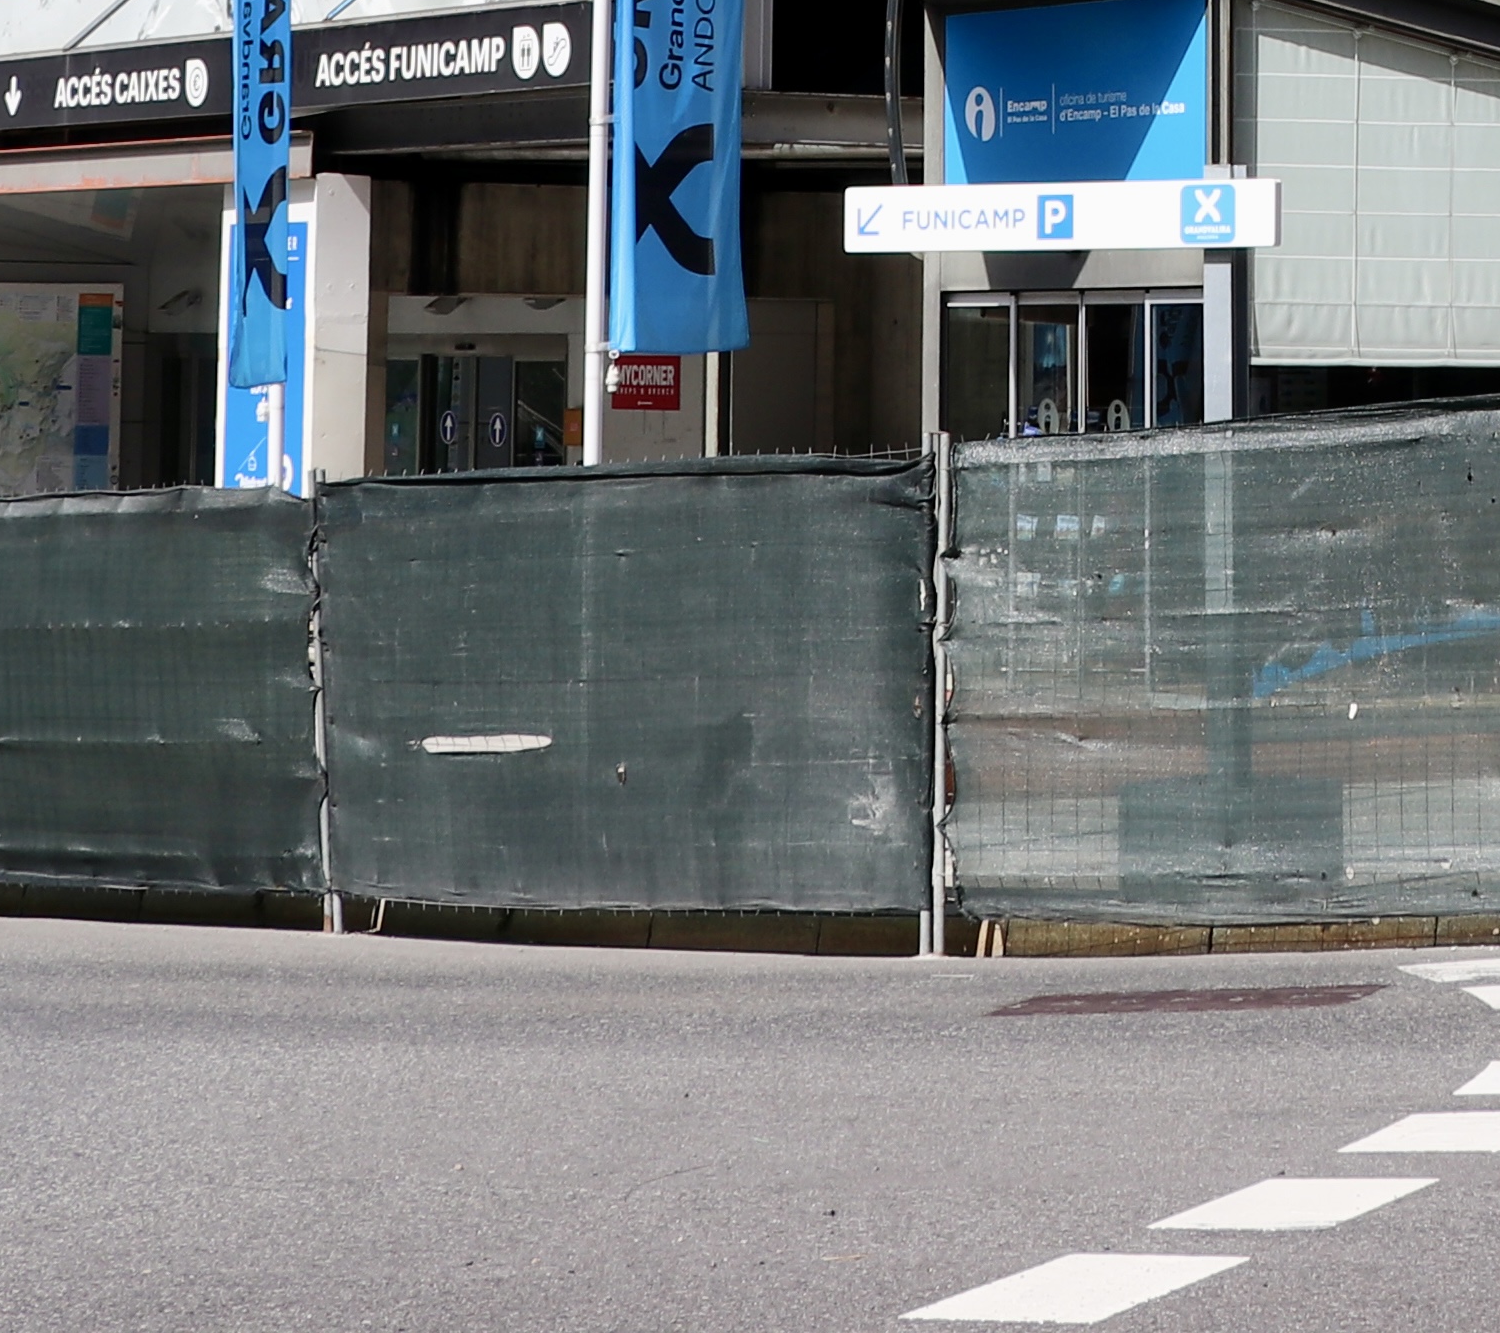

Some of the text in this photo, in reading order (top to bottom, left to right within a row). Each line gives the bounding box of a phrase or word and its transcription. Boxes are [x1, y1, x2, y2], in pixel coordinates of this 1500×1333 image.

[315, 36, 506, 87] ACCÉS FUNICAMP
[54, 68, 181, 109] ACCÉS CAIXES
[1086, 92, 1096, 103] de
[1007, 99, 1047, 113] Encamp
[1110, 106, 1118, 118] El
[1121, 105, 1137, 117] Pas
[1139, 103, 1150, 116] de
[1161, 101, 1185, 114] Casa
[902, 200, 1066, 235] FUNICAMP P
